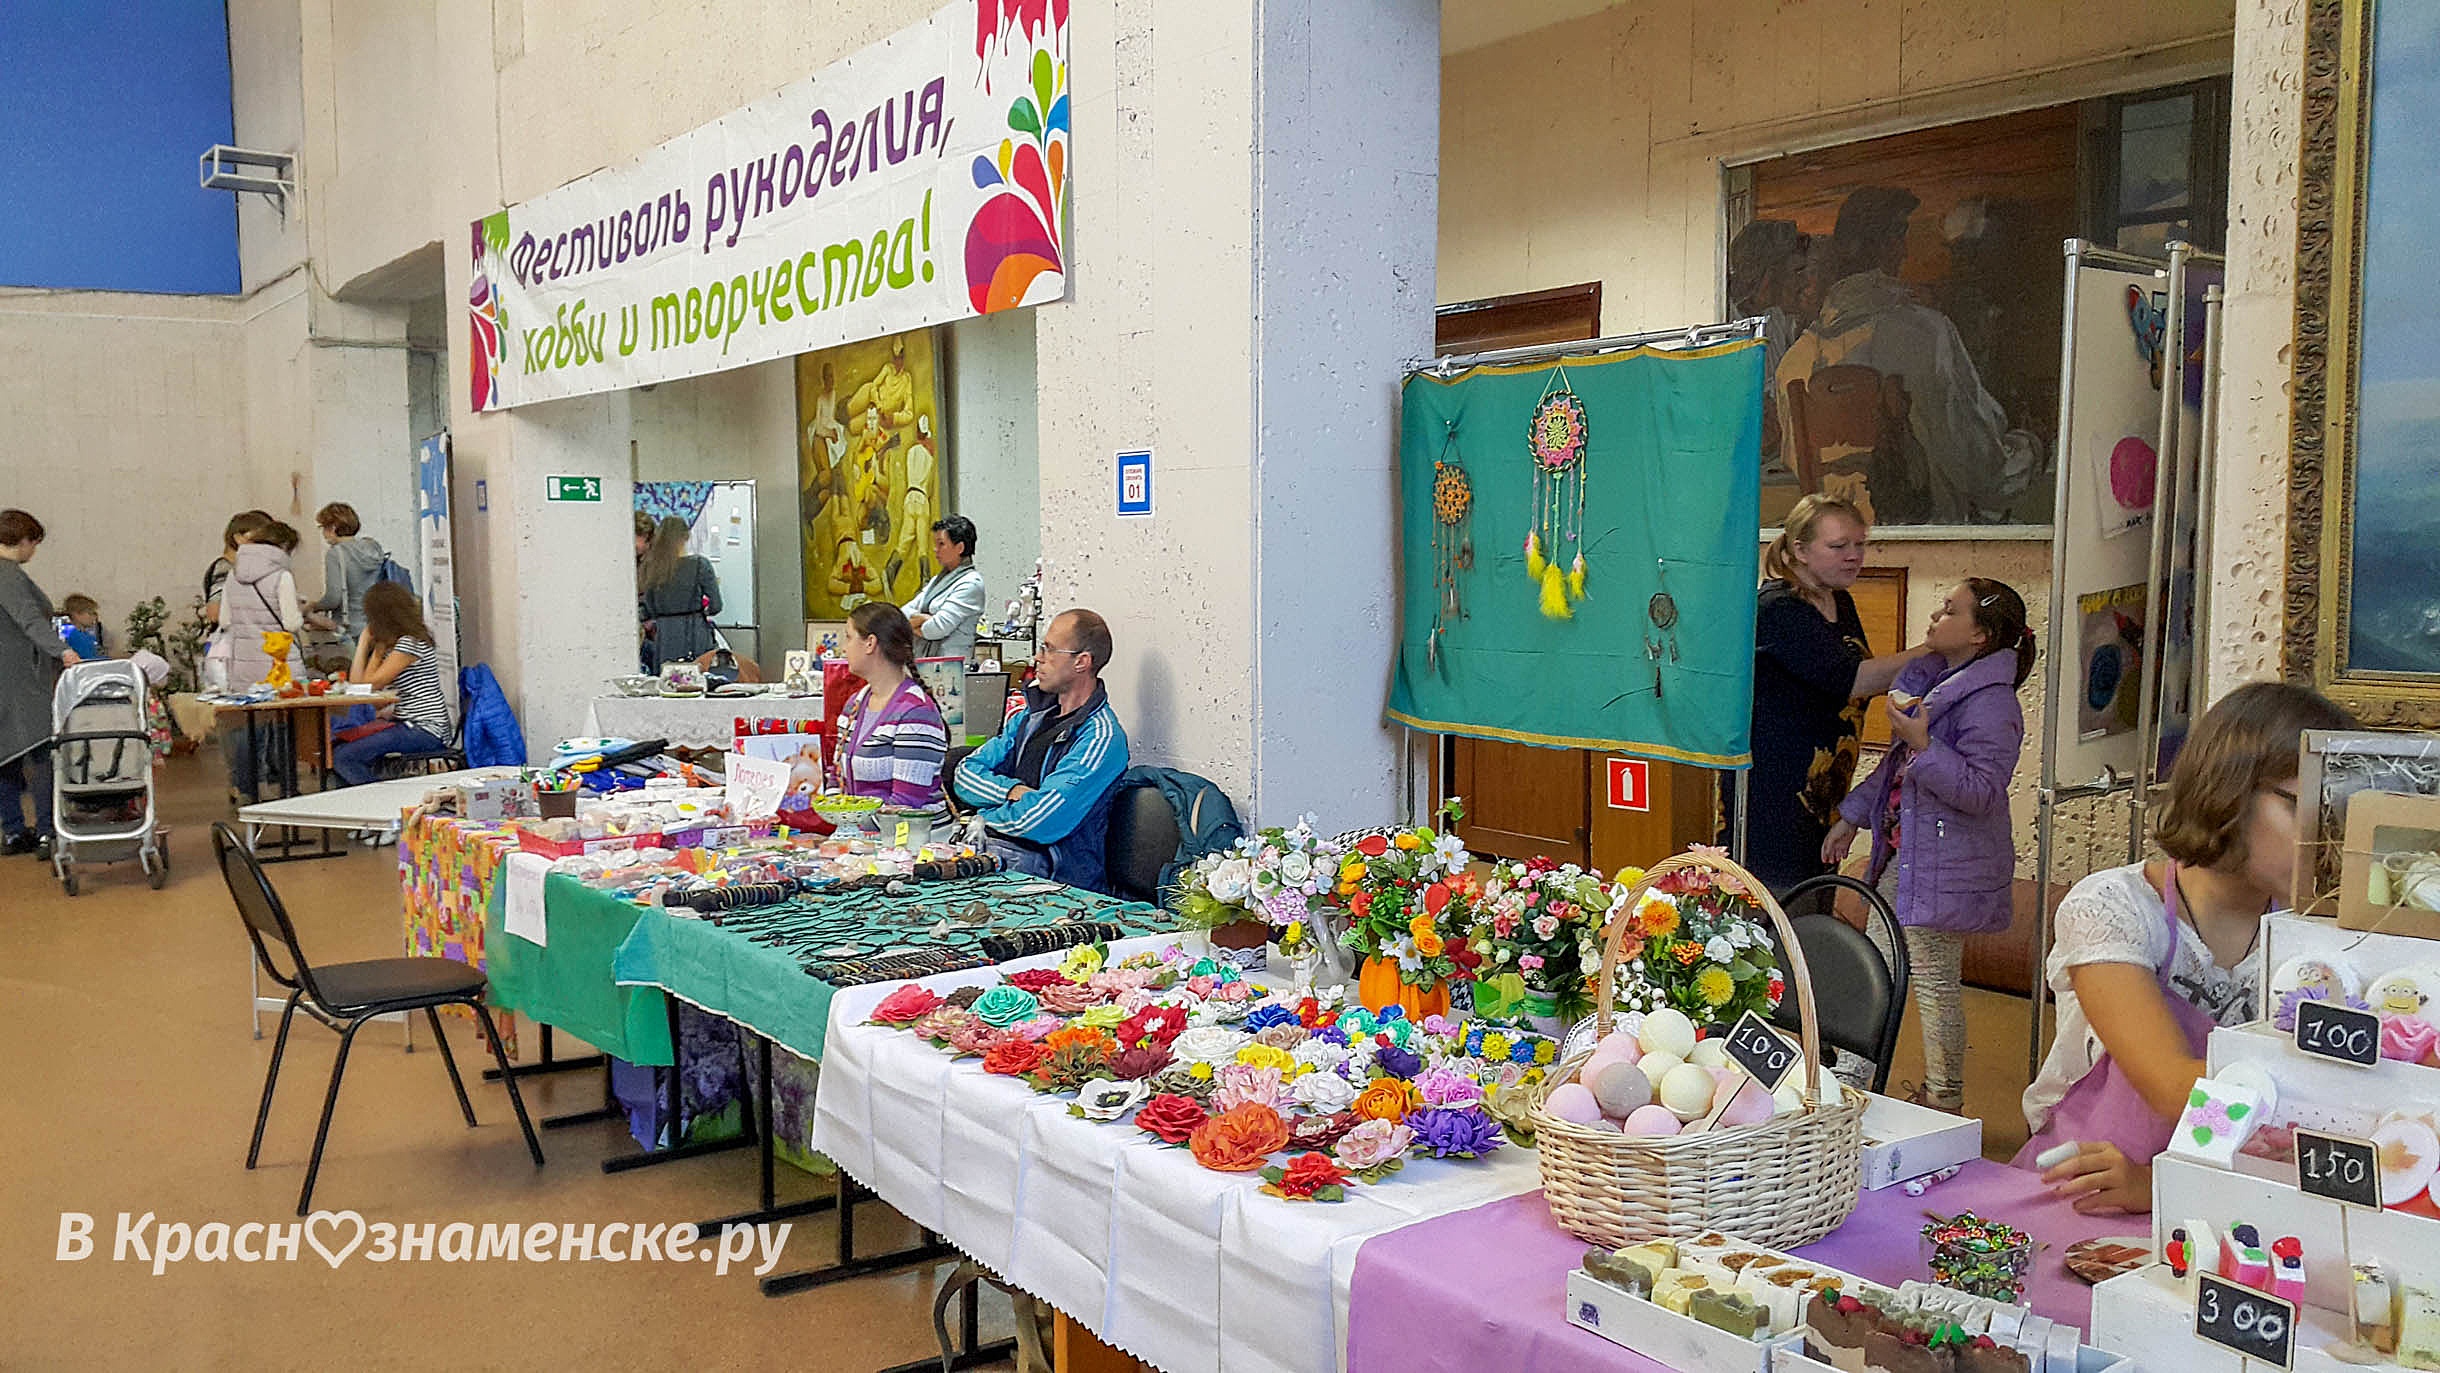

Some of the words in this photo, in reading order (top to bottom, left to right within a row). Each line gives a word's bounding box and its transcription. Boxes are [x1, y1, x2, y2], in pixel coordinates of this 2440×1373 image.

[510, 190, 691, 289] Фестиваль
[704, 76, 955, 254] рукоделия,
[523, 303, 607, 375] хобби
[618, 304, 639, 358] и
[650, 188, 935, 356] творчества!
[1128, 484, 1140, 498] 01
[1735, 1027, 1787, 1070] 100
[2306, 1018, 2373, 1056] 100
[2302, 1144, 2365, 1184] 150
